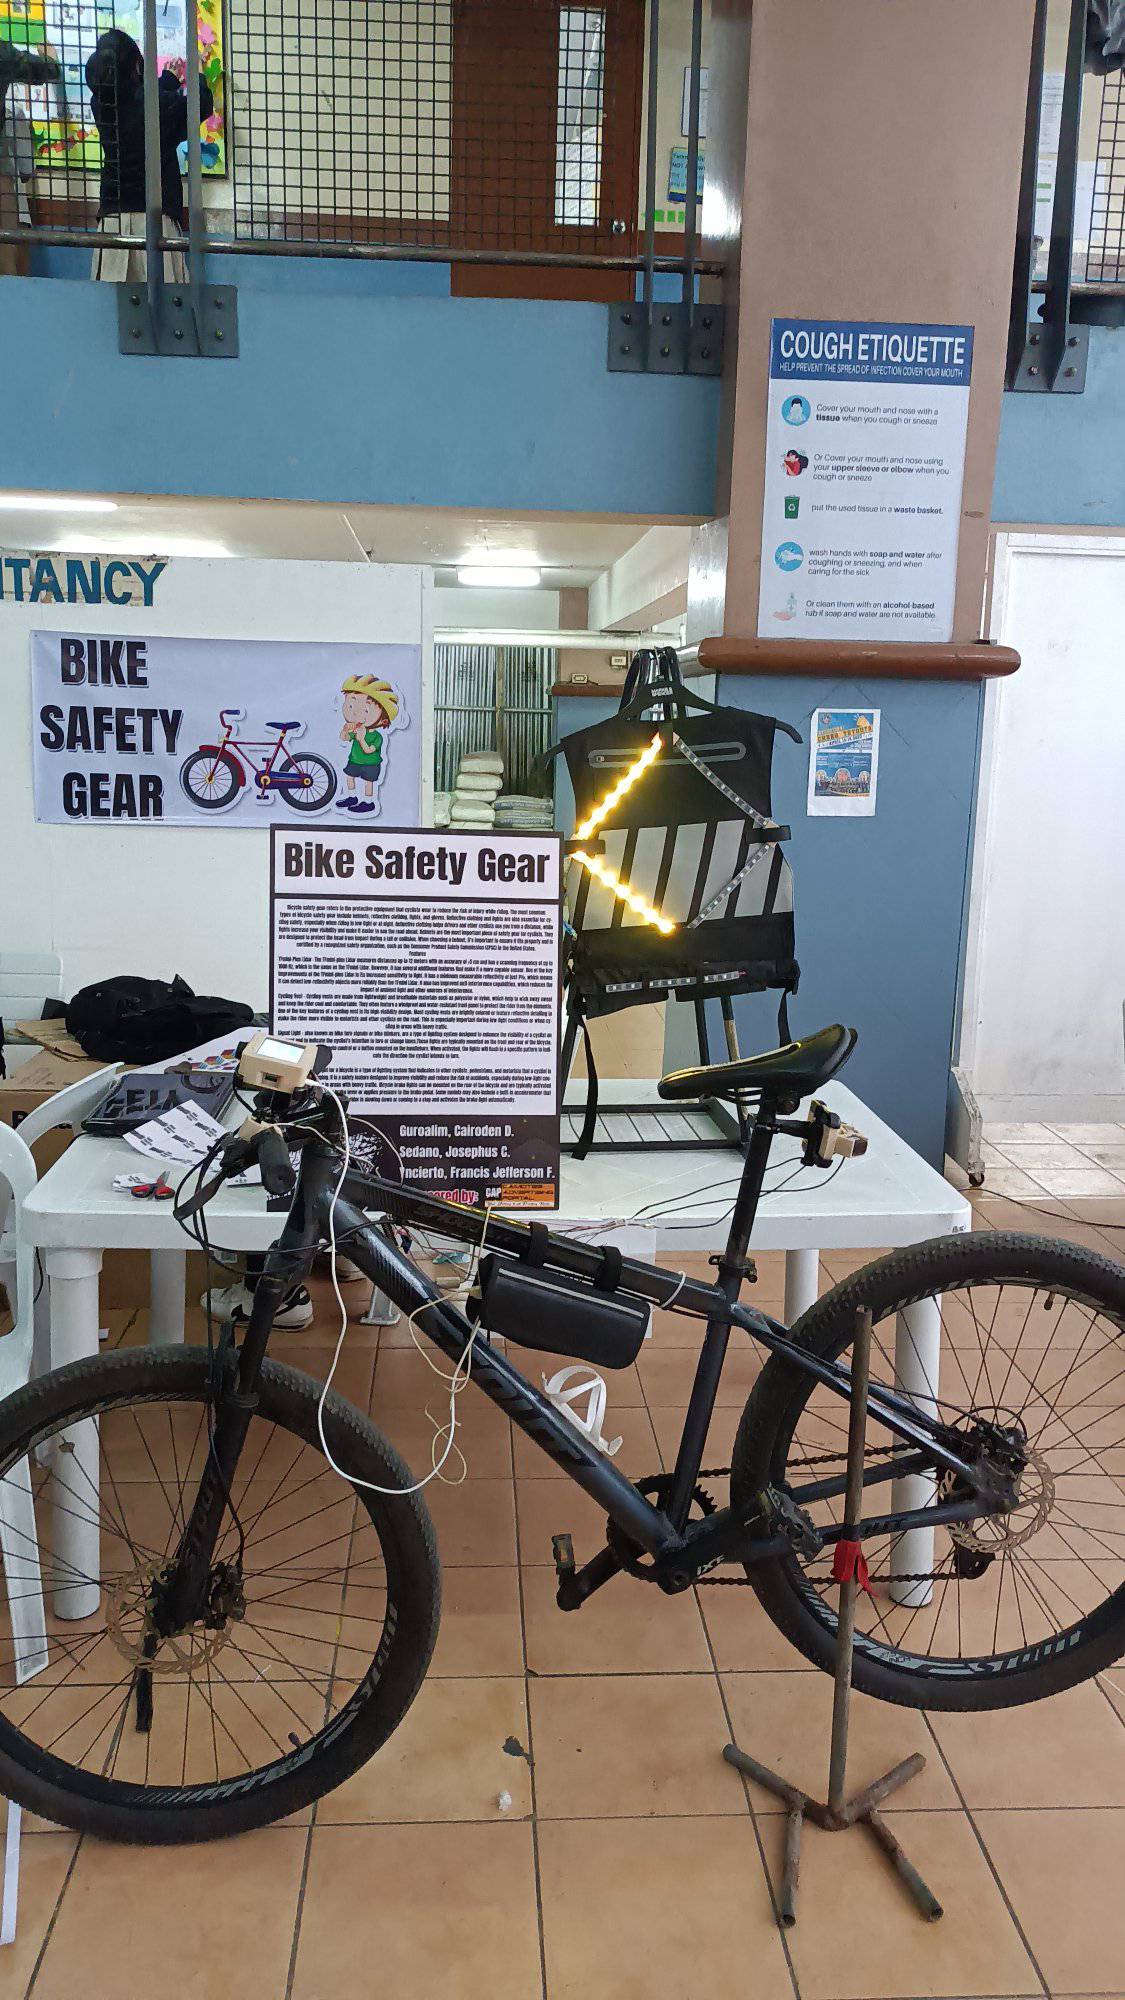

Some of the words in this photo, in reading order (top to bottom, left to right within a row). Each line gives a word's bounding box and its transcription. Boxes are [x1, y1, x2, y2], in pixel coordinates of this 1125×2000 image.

[780, 329, 856, 360] COUGH
[858, 332, 966, 365] ETIQUETTE
[779, 361, 795, 370] HELP
[795, 362, 822, 372] PREVENT
[824, 363, 836, 372] THE
[836, 363, 860, 374] SPREAD
[860, 364, 870, 374] OF
[869, 364, 902, 375] INFECTION
[902, 366, 923, 376] COVER
[923, 367, 940, 377] YOUR
[939, 368, 965, 378] MOUTH
[816, 403, 838, 412] Cover
[838, 405, 856, 414] your
[856, 405, 881, 413] mouth
[817, 413, 840, 421] tissue
[878, 416, 902, 425] cough
[814, 453, 823, 461] Or
[823, 453, 846, 462] Cover
[923, 458, 943, 466] using
[831, 464, 854, 472] upper
[813, 471, 836, 481] cough
[808, 558, 843, 567] coughing
[808, 567, 830, 576] caring
[0, 556, 167, 606] TANCY
[60, 638, 149, 688] BIKE
[40, 704, 184, 755] SAFETY
[62, 772, 164, 820] GEAR
[284, 842, 354, 878] Bike
[365, 844, 466, 885] Safety
[478, 848, 550, 883] Gear
[400, 1124, 451, 1138] Guroalim,
[454, 1124, 502, 1137] Cairoden
[504, 1125, 514, 1136] D.
[400, 1146, 442, 1158] Sedano,
[446, 1146, 498, 1159] Josephus
[501, 1146, 510, 1158] C.
[450, 1166, 490, 1178] Francis
[492, 1166, 544, 1178] Jefferson
[546, 1166, 556, 1178] F.
[460, 1188, 478, 1204] by:
[486, 1187, 502, 1198] CAP
